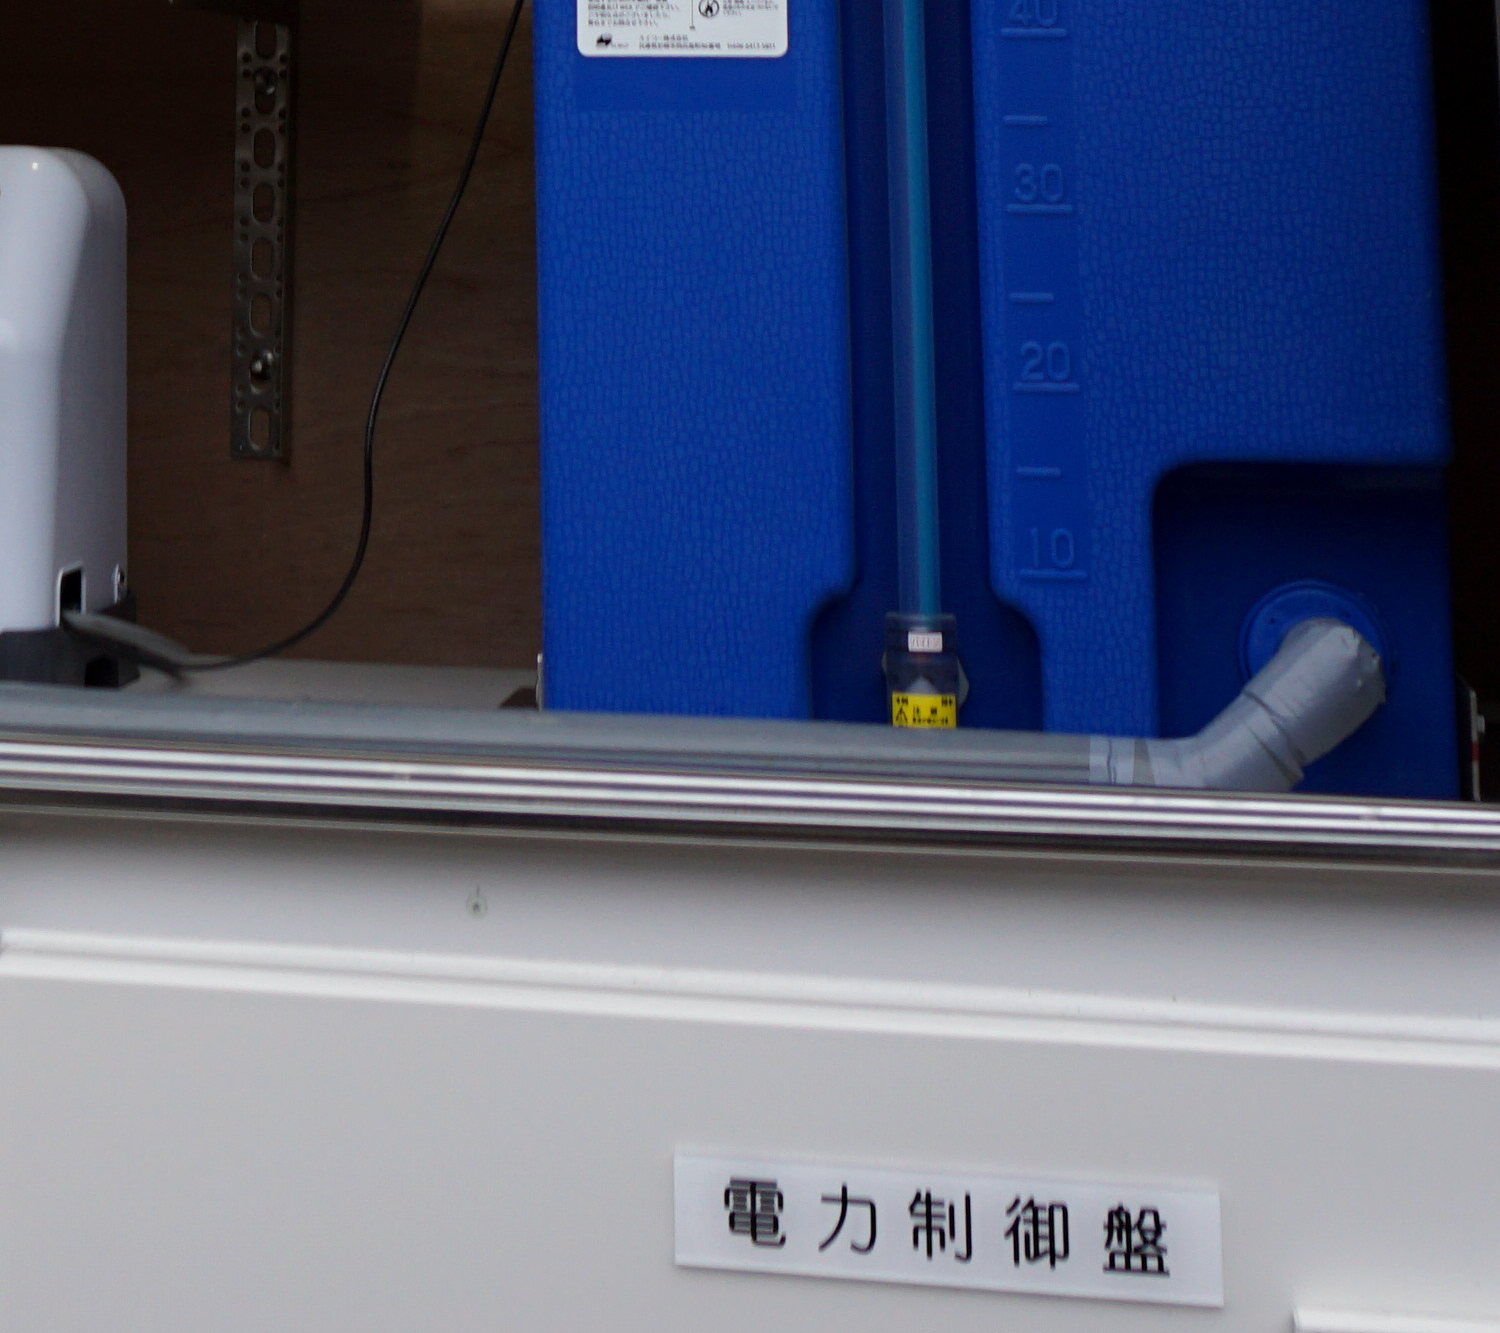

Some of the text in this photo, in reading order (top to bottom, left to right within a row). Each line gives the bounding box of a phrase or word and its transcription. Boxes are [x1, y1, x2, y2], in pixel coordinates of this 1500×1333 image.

[1013, 164, 1064, 204] 30
[1020, 340, 1071, 382] 20
[1030, 527, 1075, 568] 10
[723, 1176, 1170, 1278] 電力制御盤
